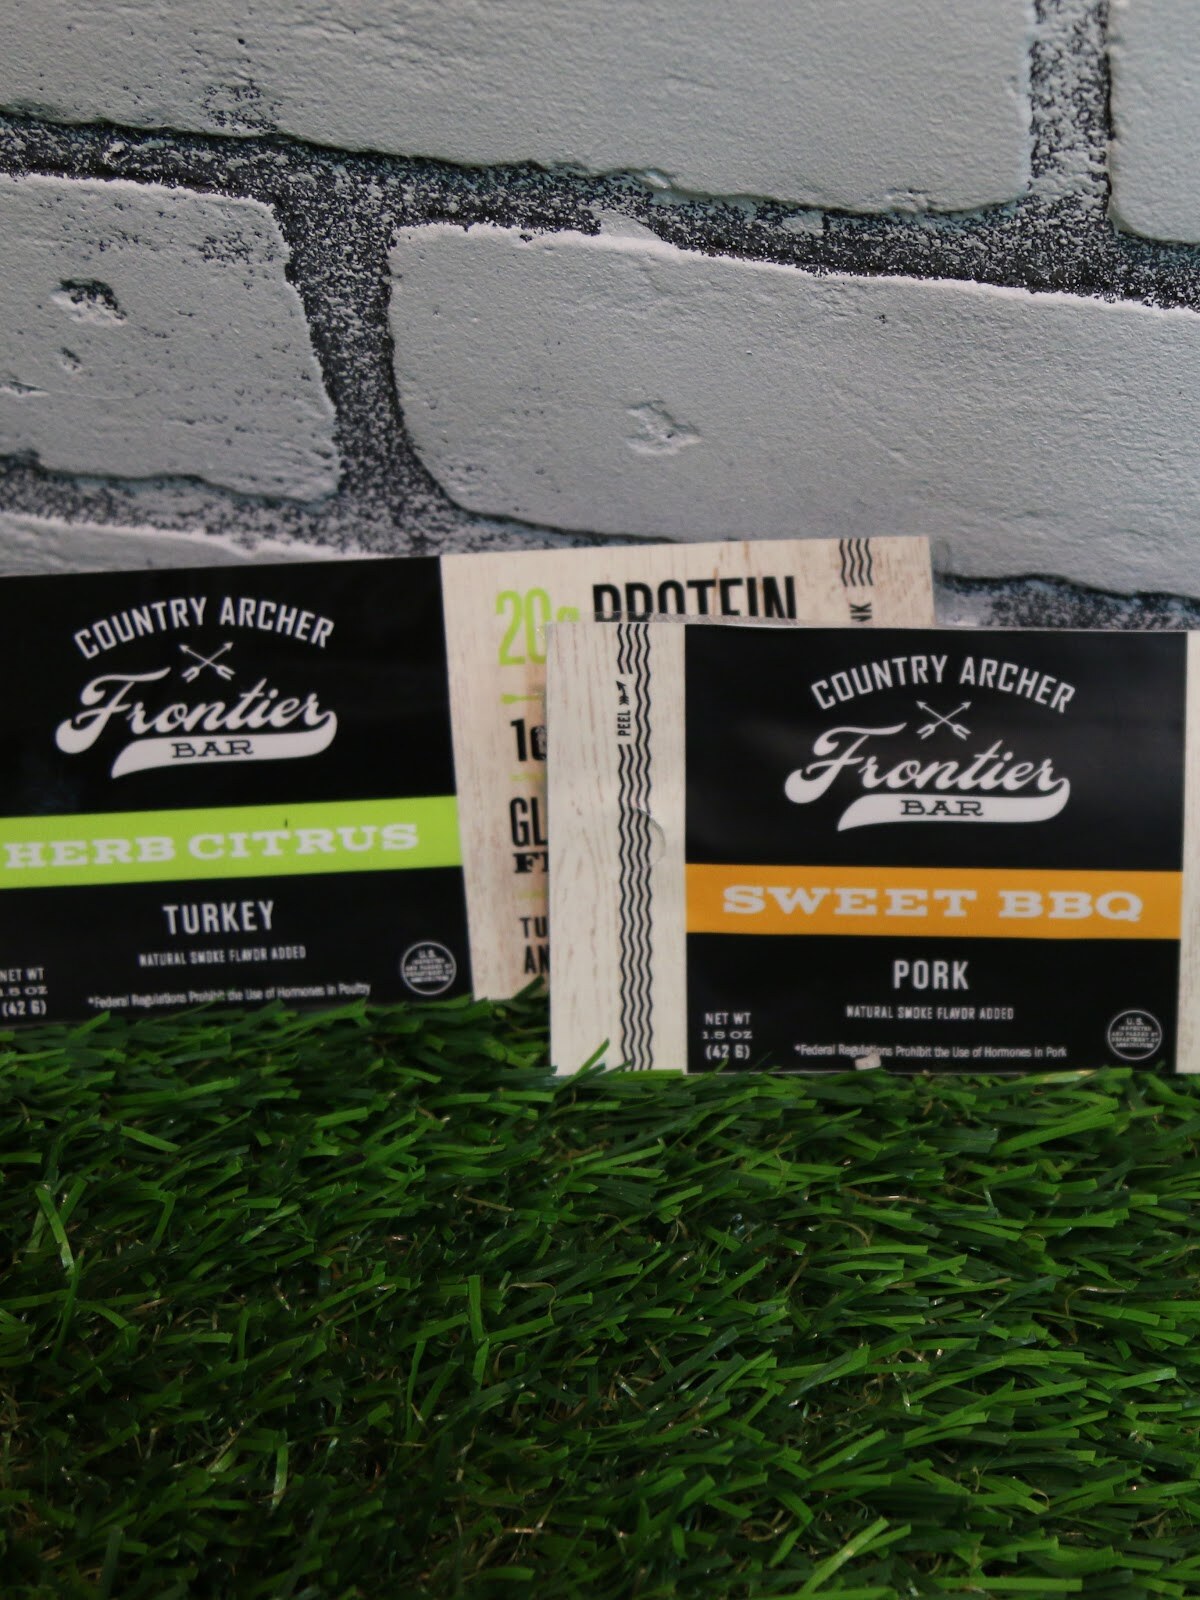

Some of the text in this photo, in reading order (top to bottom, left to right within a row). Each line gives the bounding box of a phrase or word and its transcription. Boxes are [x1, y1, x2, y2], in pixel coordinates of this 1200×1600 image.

[73, 597, 335, 659] COUNTRY ARCHER
[811, 655, 1075, 714] COUNTRY ARCHER
[55, 667, 336, 754] Frontier
[617, 710, 631, 737] PEEL
[171, 740, 254, 760] BAR
[785, 722, 1067, 803] Frontier
[900, 799, 984, 816] BAR
[4, 823, 418, 869] HERB CITRUS
[722, 885, 1143, 922] SWEET BBQ
[162, 901, 275, 934] TURKEY
[138, 946, 306, 967] NATURAL SMOKE FLAVOR ADDED
[0, 967, 44, 982] NET WT
[893, 960, 969, 990] PORK
[705, 1012, 751, 1025] NET WT
[846, 1005, 1014, 1020] NATURAL SMOKE FLAVOR ADDED
[730, 1031, 753, 1039] OZ
[705, 1045, 730, 1060] (42
[839, 1044, 893, 1058] Regulations
[896, 1045, 932, 1057] Prohibit
[935, 1045, 950, 1057] the
[952, 1046, 970, 1058] Use
[973, 1046, 982, 1058] of
[984, 1047, 1031, 1058] Hormones
[1034, 1047, 1043, 1058] in
[1046, 1047, 1067, 1058] Pork
